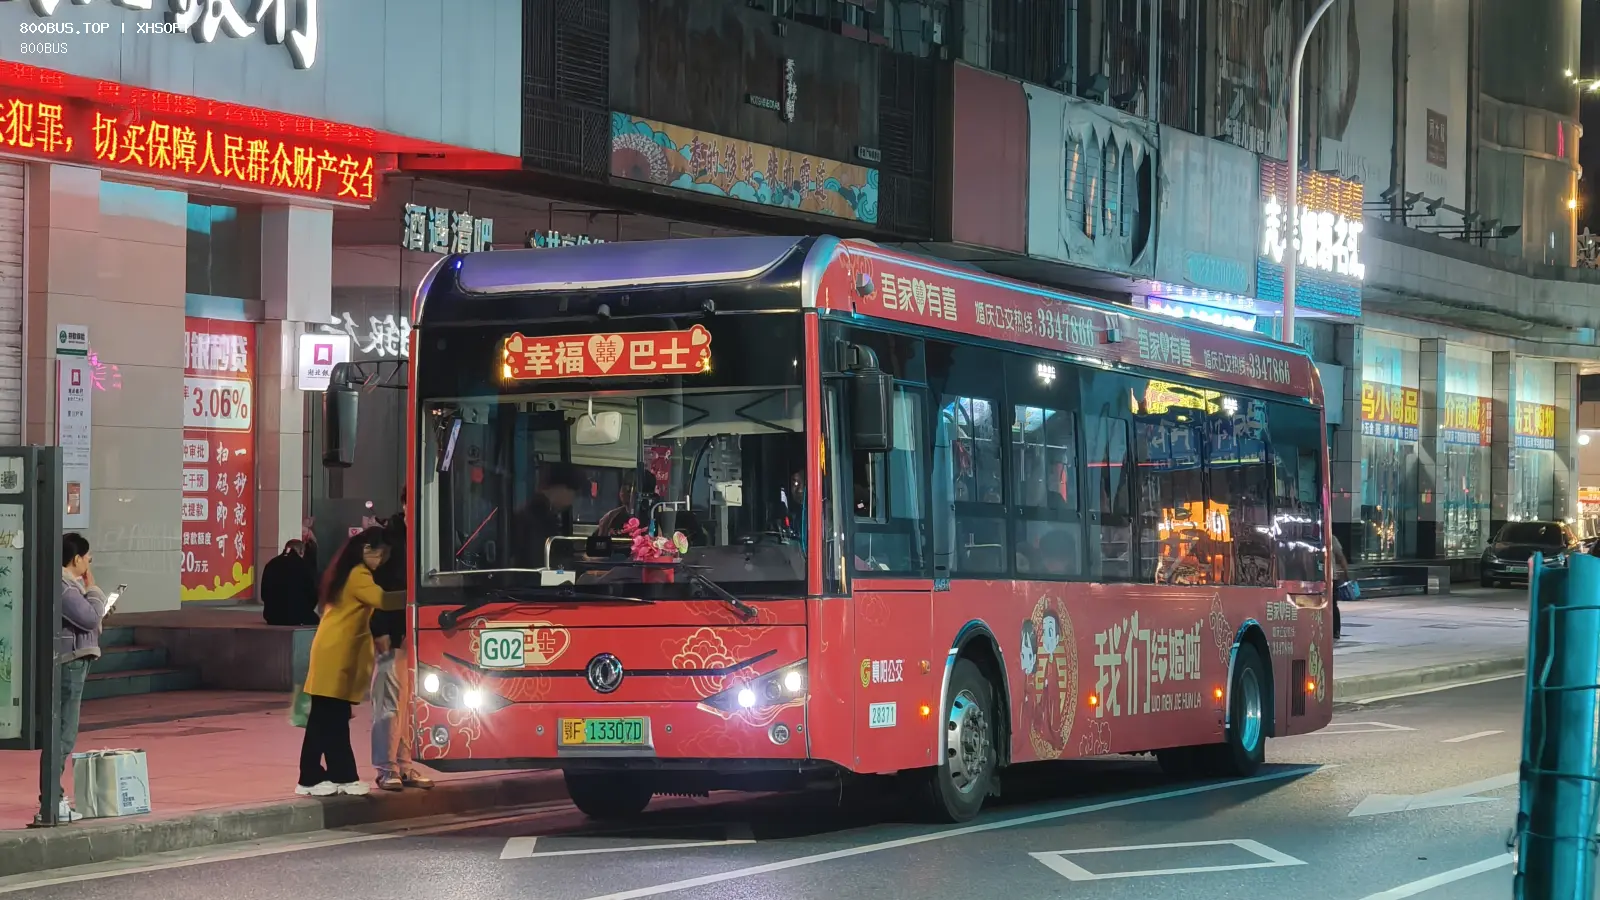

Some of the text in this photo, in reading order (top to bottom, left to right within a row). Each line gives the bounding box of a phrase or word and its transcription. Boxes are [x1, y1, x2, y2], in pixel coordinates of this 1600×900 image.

[524, 341, 584, 375] 幸福
[629, 337, 690, 370] 巴士
[192, 386, 248, 419] 3.06%
[215, 441, 230, 558] 扫码即可
[233, 447, 248, 559] 一秒就贷
[483, 637, 522, 660] G02
[590, 721, 642, 741] 13307D
[872, 706, 895, 723] 28371
